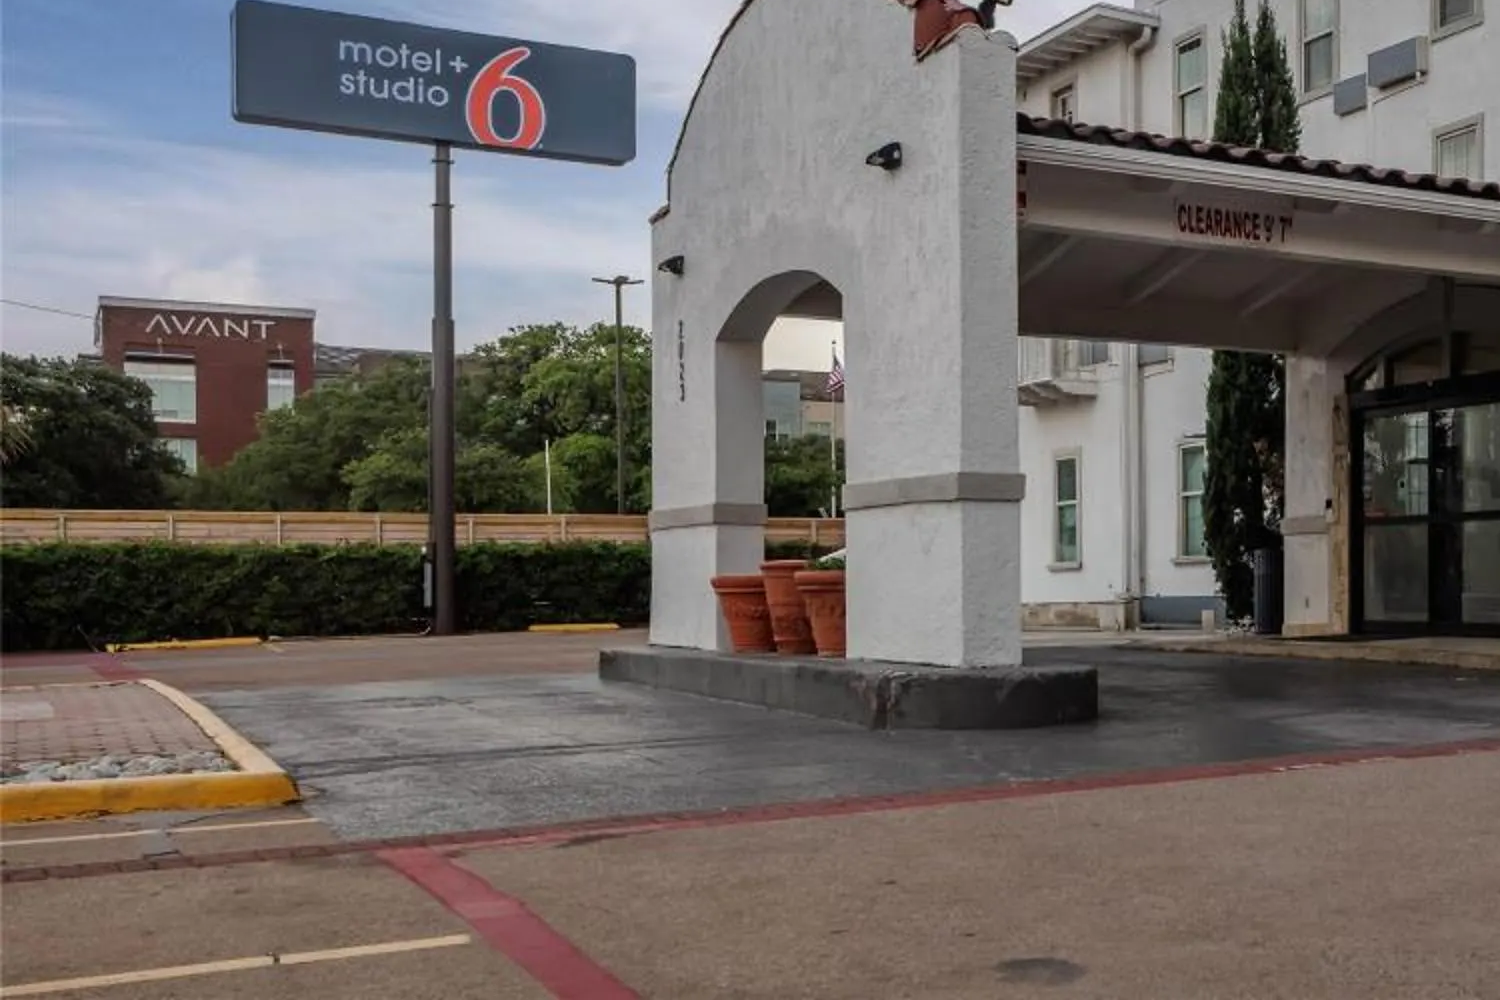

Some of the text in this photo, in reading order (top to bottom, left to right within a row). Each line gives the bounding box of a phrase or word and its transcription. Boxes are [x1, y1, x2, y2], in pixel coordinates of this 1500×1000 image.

[338, 39, 441, 75] motel
[339, 71, 449, 107] studio
[465, 46, 546, 150] 6
[1177, 203, 1261, 241] CLEARANCE
[145, 313, 276, 340] AVANT
